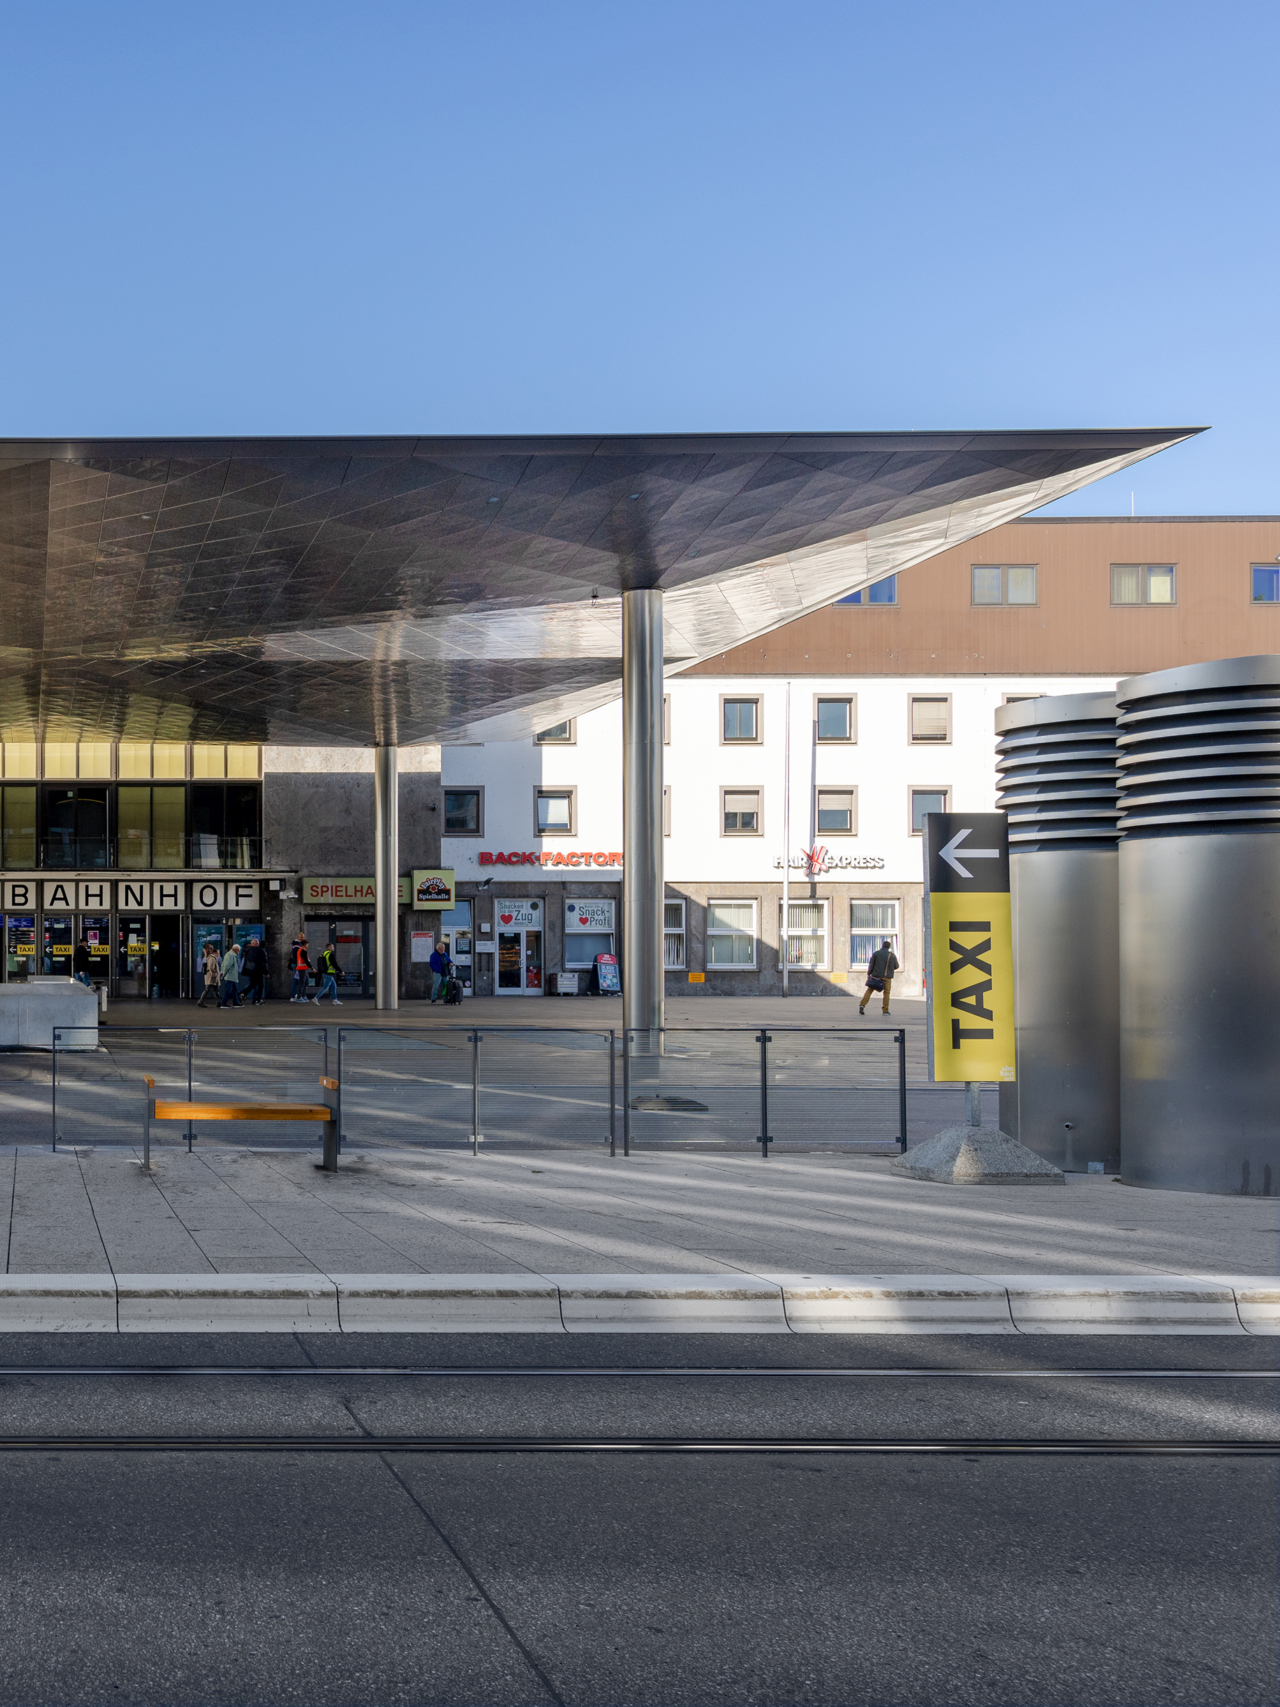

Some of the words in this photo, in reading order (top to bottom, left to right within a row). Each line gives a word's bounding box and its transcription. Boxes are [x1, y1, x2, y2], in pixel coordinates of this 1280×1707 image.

[825, 855, 884, 869] EXPRESS
[310, 885, 404, 898] SPIELHAE
[514, 909, 533, 924] Zug
[579, 906, 610, 917] Snack-
[590, 917, 610, 926] Profi
[949, 921, 994, 1049] TAXI
